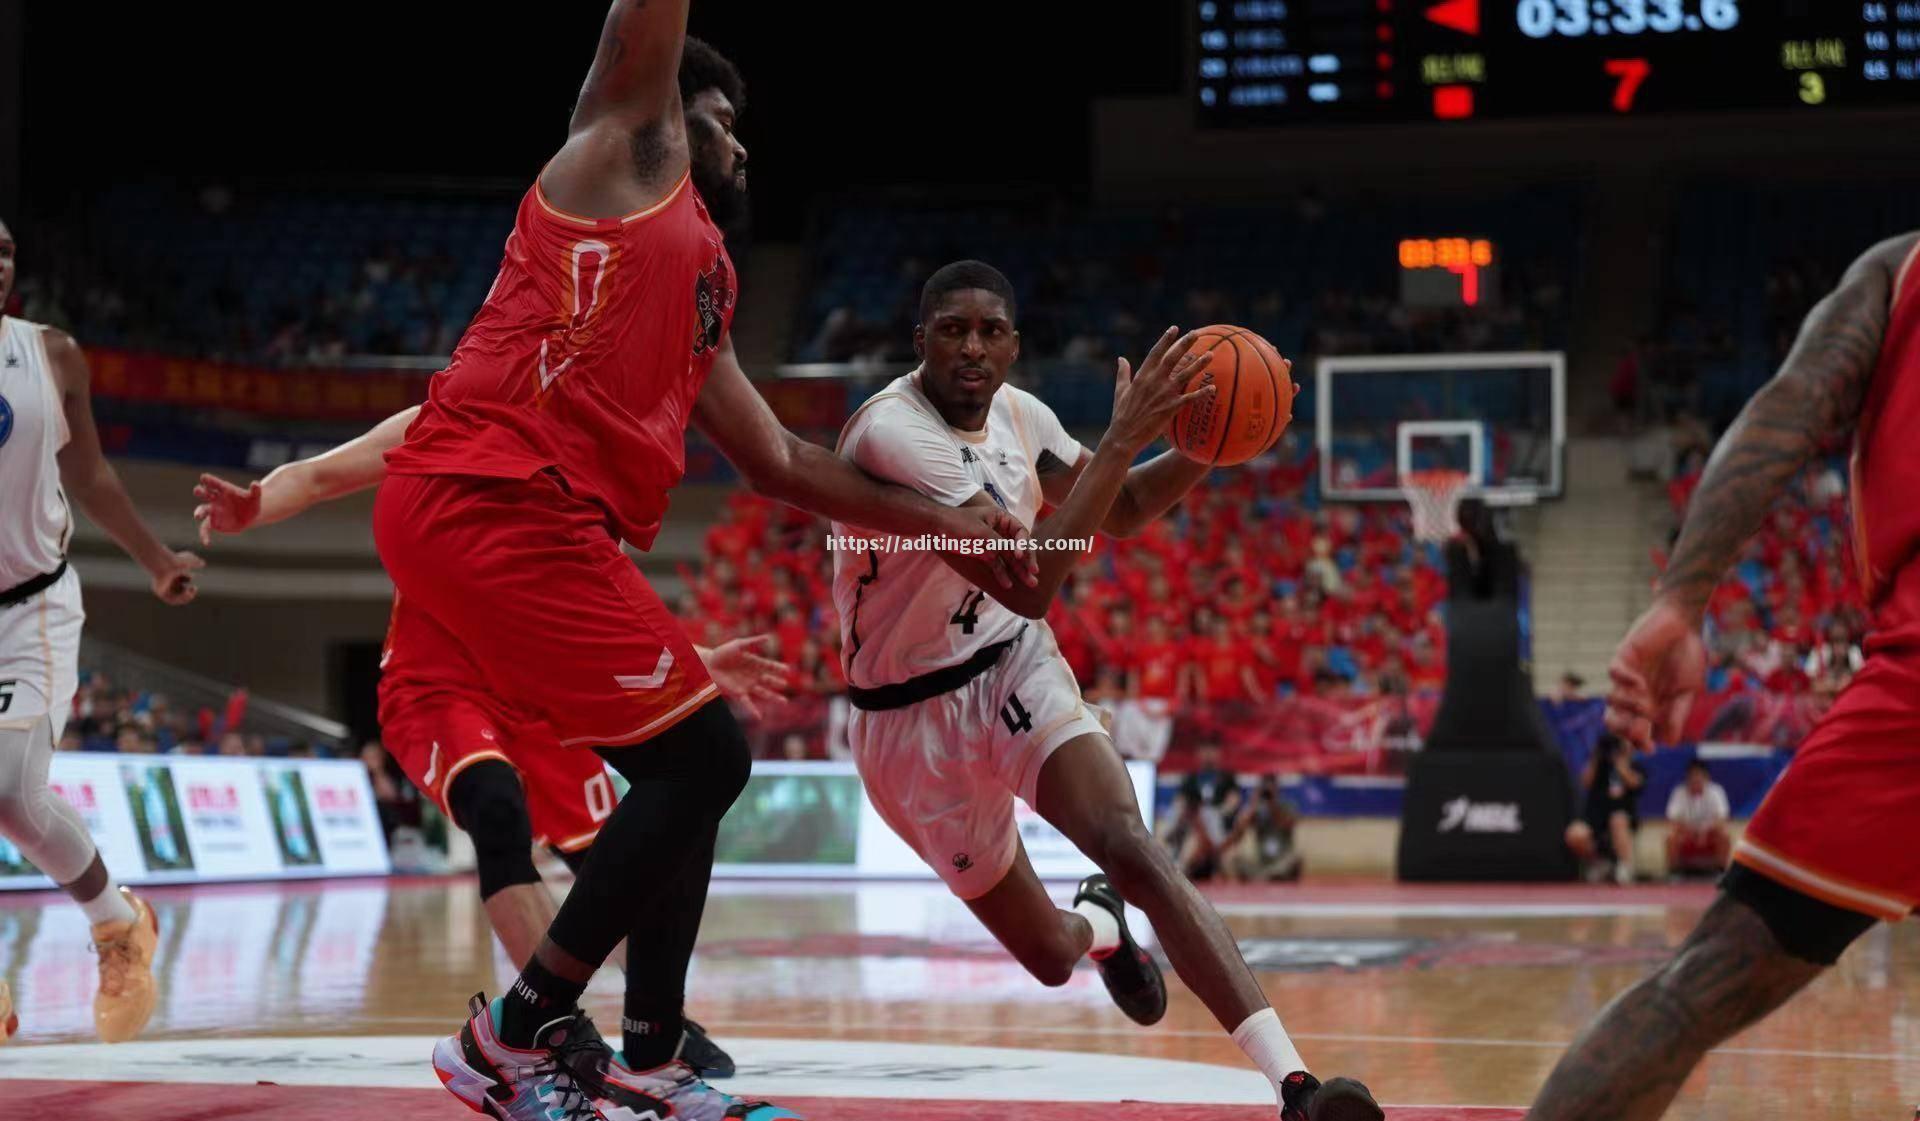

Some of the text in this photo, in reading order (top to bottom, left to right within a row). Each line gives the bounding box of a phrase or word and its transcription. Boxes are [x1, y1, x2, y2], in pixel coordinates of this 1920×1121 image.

[1604, 59, 1649, 112] 7
[1799, 71, 1825, 104] 3
[950, 588, 986, 635] 4
[1000, 691, 1033, 737] 4
[584, 771, 612, 823] 0
